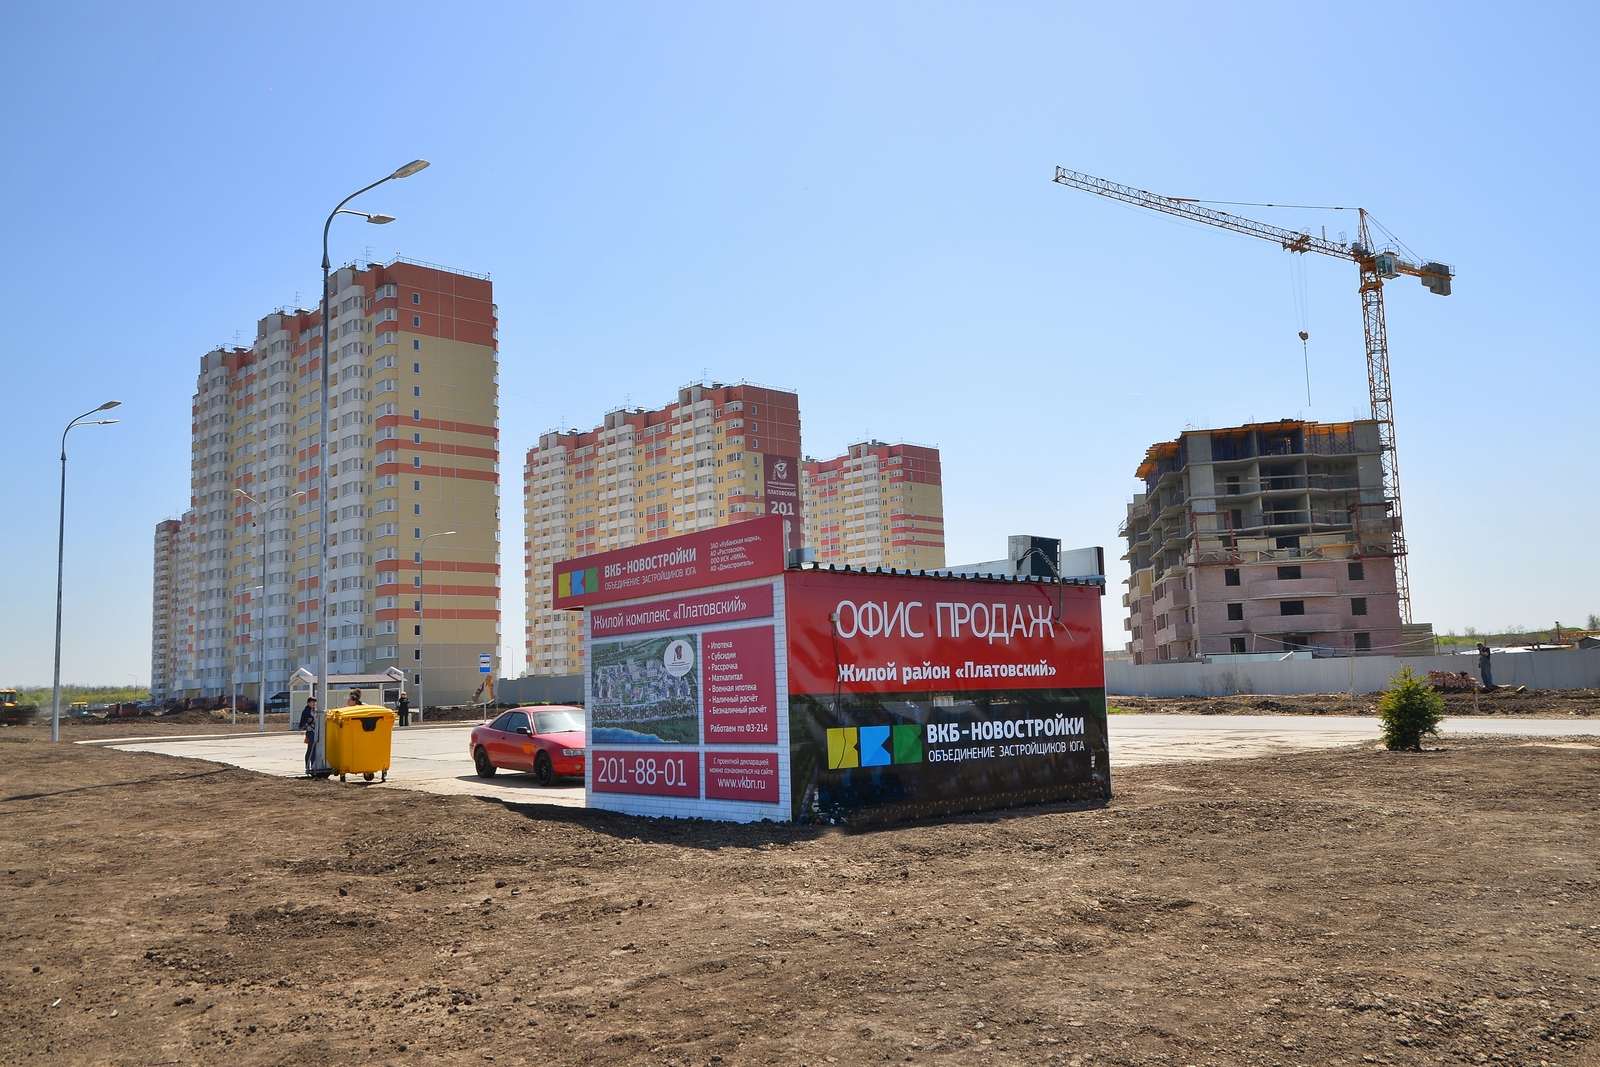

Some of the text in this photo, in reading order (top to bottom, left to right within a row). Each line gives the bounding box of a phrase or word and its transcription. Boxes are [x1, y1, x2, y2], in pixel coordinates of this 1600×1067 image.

[771, 501, 794, 516] 201
[604, 547, 697, 578] ВКБ-НОВОСТРОЙКИ
[604, 566, 697, 591] ОБЪЕДИНЕНИЕ ЗАСТРОЙЩИКОВ ЮГА
[593, 595, 747, 630] Жилой комплекс «Платовский»
[836, 600, 1055, 645] ОФИС ПРОДАЖ
[710, 641, 733, 649] Ипотека
[711, 652, 736, 661] Субсидии
[711, 663, 738, 672] Рассрочка
[838, 659, 1057, 685] Жилой район «Платовский»
[711, 673, 743, 682] Маткапитал
[712, 683, 757, 693] Военная ипотека
[712, 694, 758, 704] Наличный расчёт
[713, 705, 767, 715] Безналичный расчёт
[710, 724, 736, 733] Работаем
[737, 725, 745, 733] по
[926, 713, 1085, 744] ВКБ-НОВОСТРОЙКИ
[928, 740, 1085, 763] ОБЪЕДИНЕНИЕ ЗАСТРОЙЩИКОВ ЮГА
[717, 758, 740, 766] проектной
[740, 758, 769, 767] декларацией
[598, 757, 687, 787] 201-88-01
[761, 768, 773, 776] сайте
[717, 776, 766, 790] www.vkbn.ru
